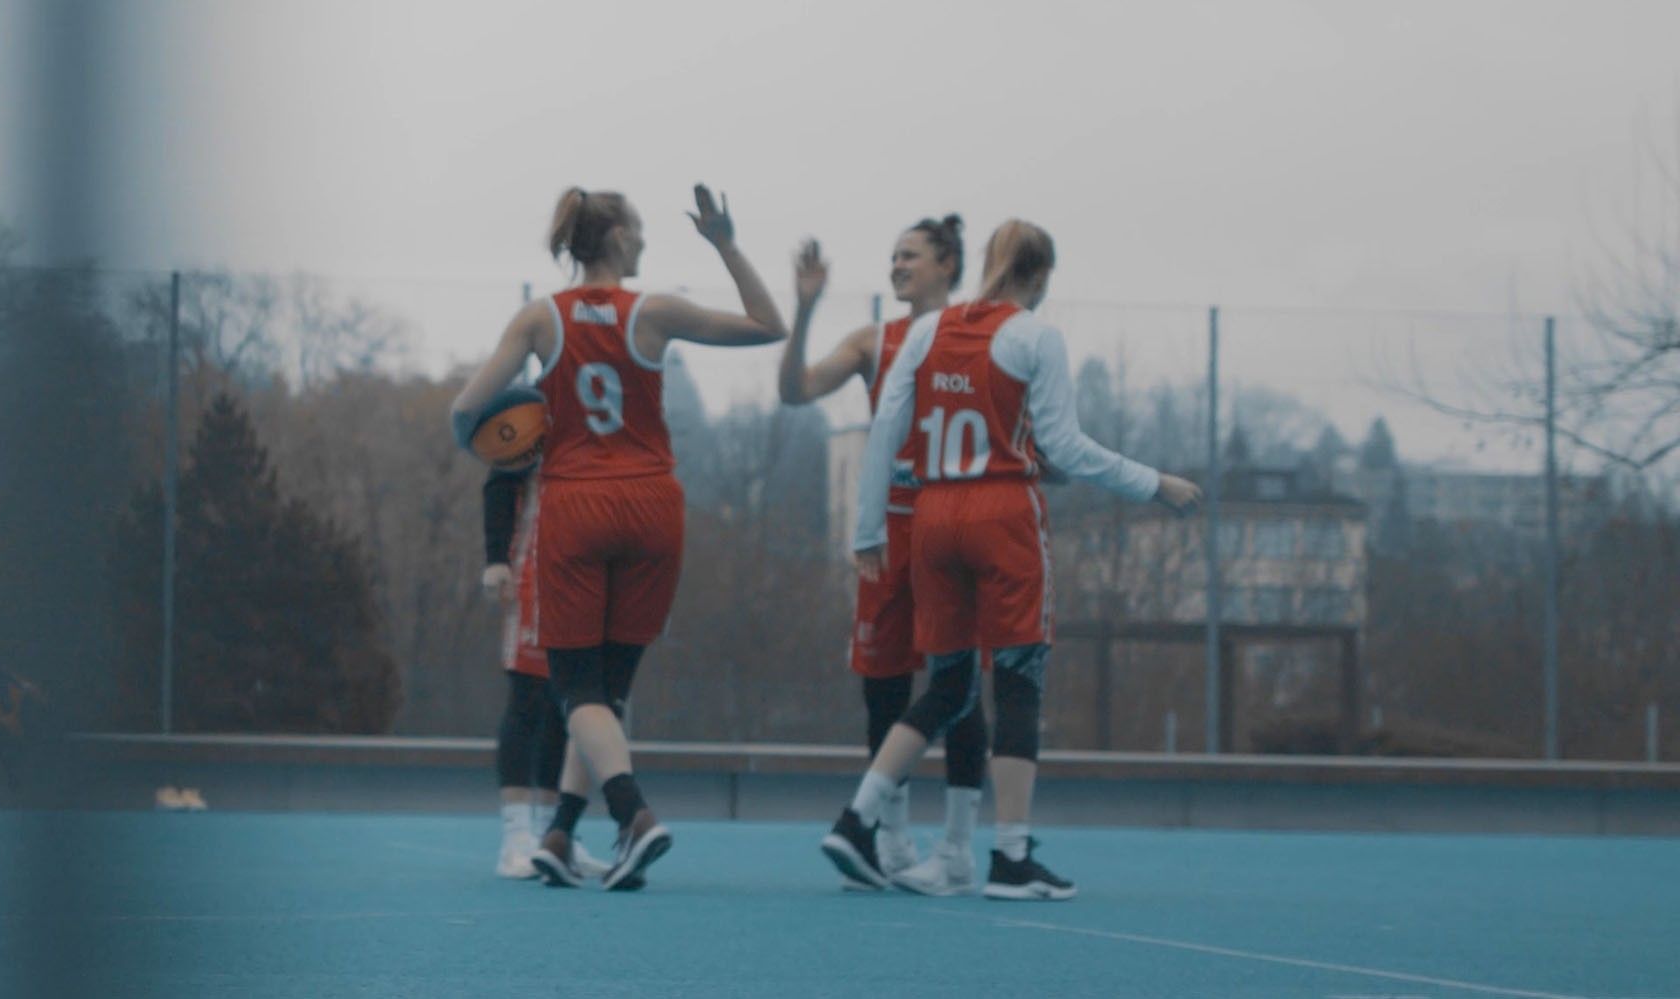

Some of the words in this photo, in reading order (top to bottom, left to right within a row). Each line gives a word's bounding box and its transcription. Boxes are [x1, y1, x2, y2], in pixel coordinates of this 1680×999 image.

[576, 362, 624, 435] 9
[932, 371, 975, 394] ROL
[919, 406, 991, 481] 10
